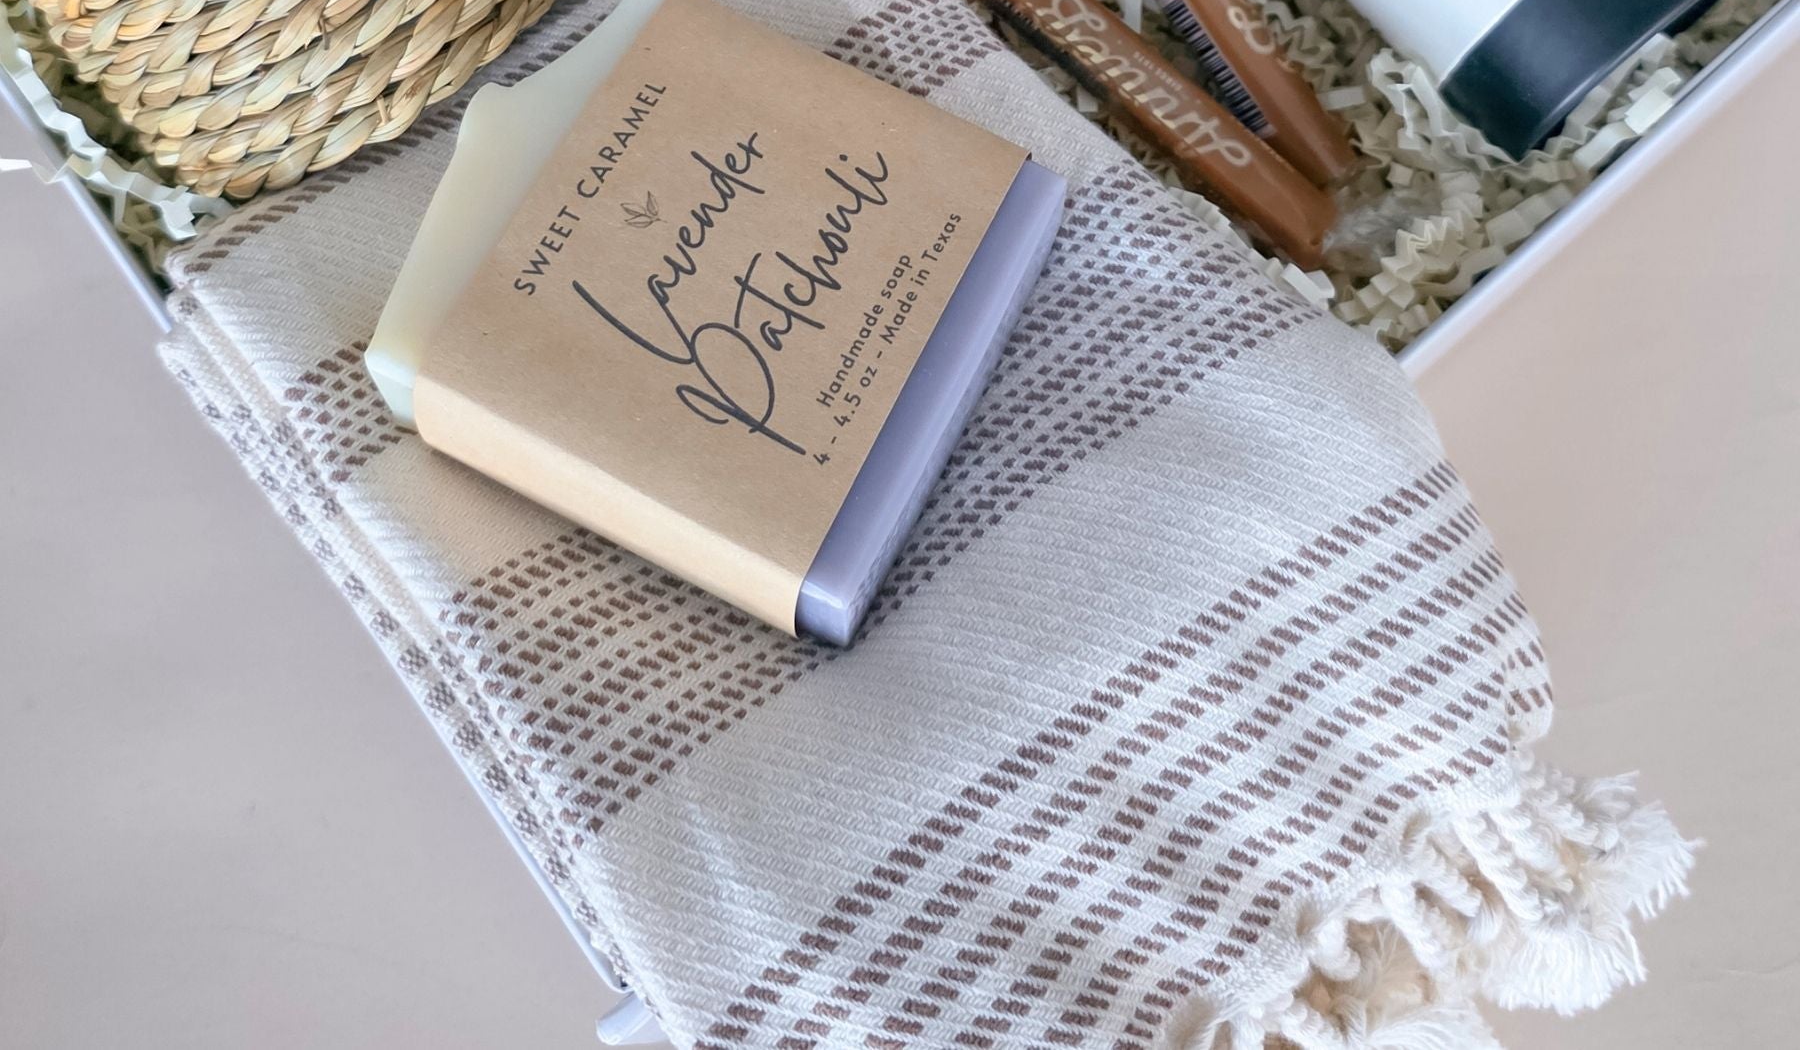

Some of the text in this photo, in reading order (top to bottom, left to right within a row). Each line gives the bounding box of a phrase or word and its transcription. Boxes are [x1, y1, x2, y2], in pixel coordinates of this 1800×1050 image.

[514, 83, 667, 296] SWEET CARAMEL
[572, 132, 765, 365] Lavender
[675, 151, 888, 455] Patchouli
[813, 452, 830, 466] 4
[833, 391, 862, 427] 4.5
[859, 366, 878, 388] oz
[880, 291, 918, 344] Made
[910, 268, 930, 287] in
[921, 212, 962, 263] Texas
[816, 254, 913, 408] Handmade soap
